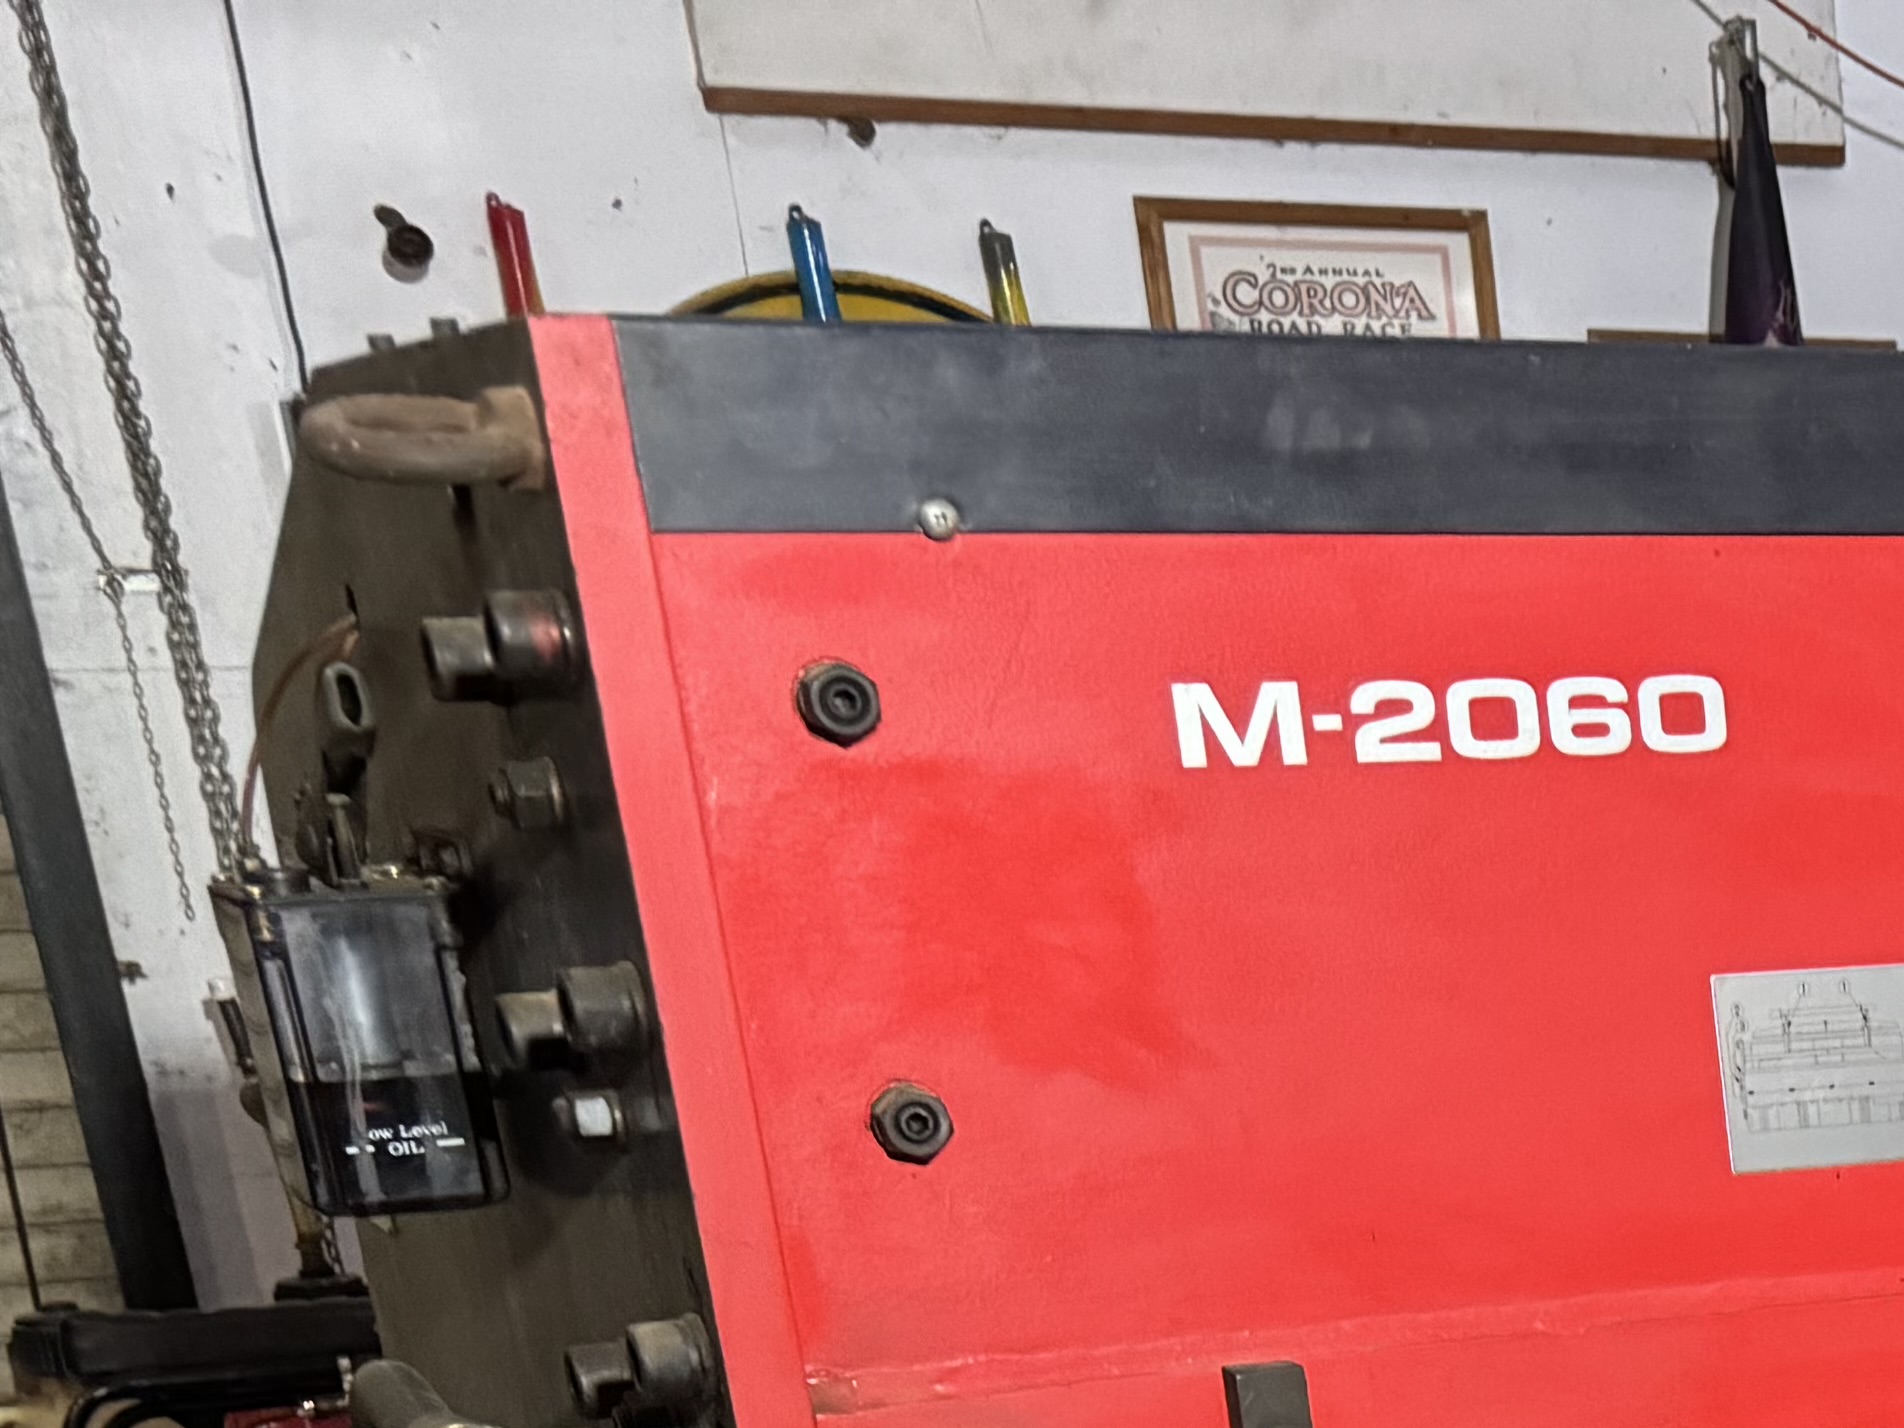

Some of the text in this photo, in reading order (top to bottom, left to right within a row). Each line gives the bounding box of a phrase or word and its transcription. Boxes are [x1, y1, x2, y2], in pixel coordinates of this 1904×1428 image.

[1222, 269, 1436, 321] CORONA
[1169, 673, 1729, 769] M-2060
[365, 1120, 449, 1141] ow Level
[388, 1139, 426, 1157] OIL
